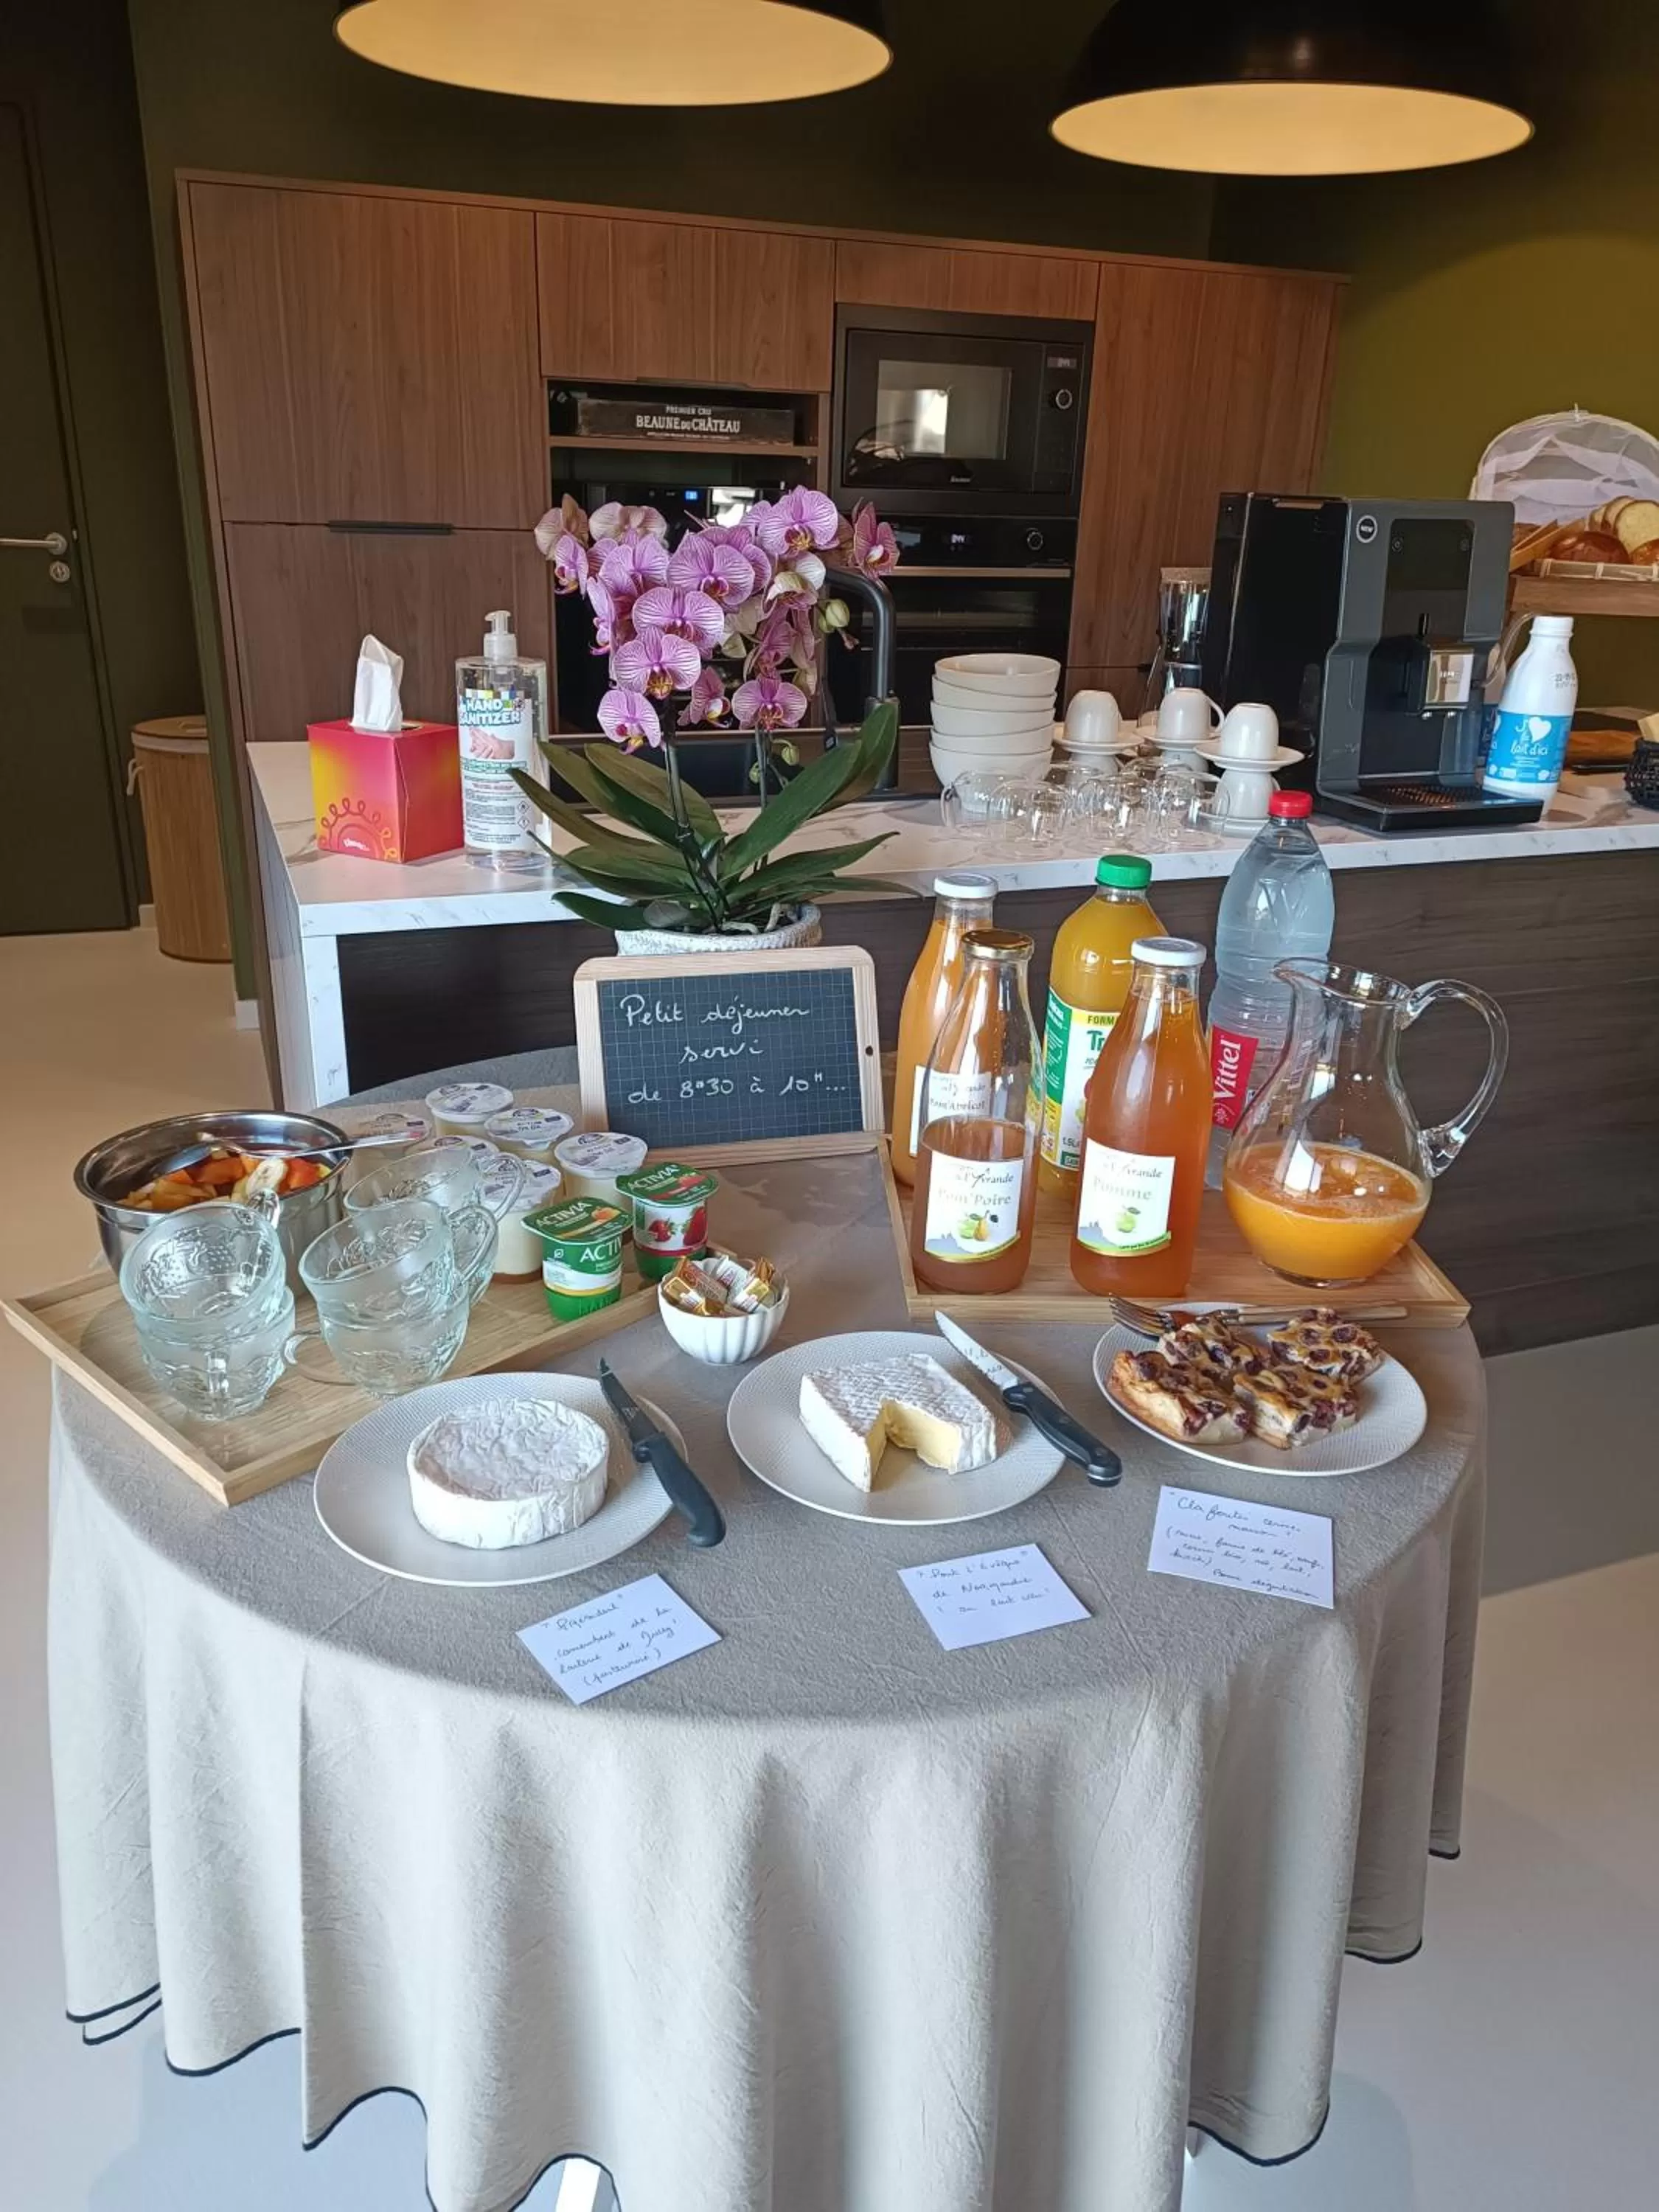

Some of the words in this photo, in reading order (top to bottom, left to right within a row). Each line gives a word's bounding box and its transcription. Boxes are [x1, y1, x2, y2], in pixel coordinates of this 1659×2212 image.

[636, 415, 681, 430] BEAUNE
[692, 417, 740, 433] CHÂTEAU
[466, 698, 504, 712] HAND
[1510, 739, 1528, 755] lait
[620, 993, 684, 1026] Petit
[701, 995, 810, 1034] déjeuner
[678, 1040, 764, 1063] servi
[1213, 1039, 1242, 1099] Vittel
[628, 1082, 661, 1104] de
[750, 1076, 765, 1093] à
[627, 1164, 680, 1191] ACTIVIA
[535, 1202, 593, 1228] ACTIVIA
